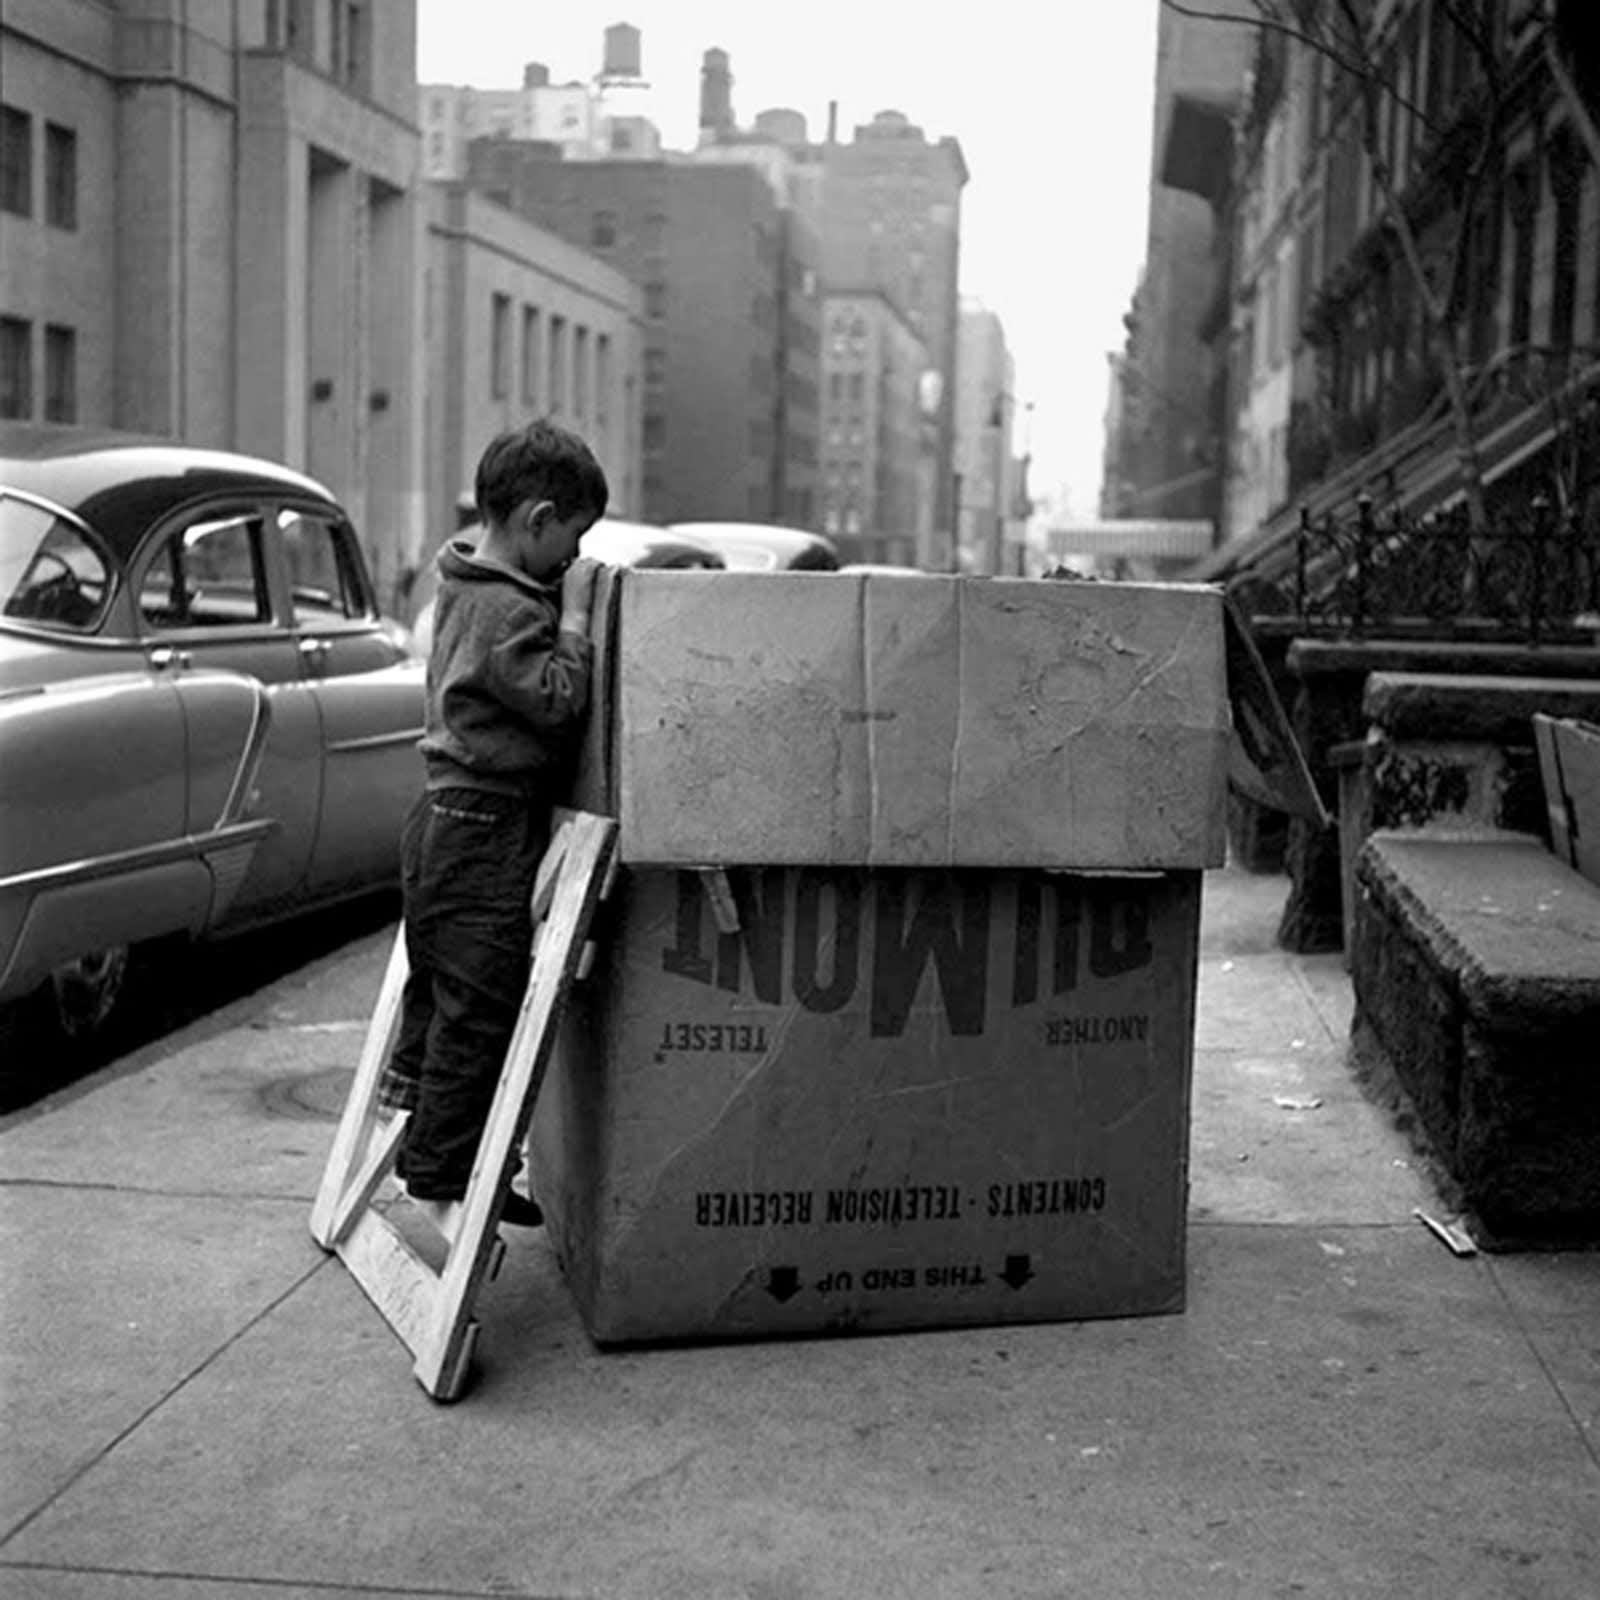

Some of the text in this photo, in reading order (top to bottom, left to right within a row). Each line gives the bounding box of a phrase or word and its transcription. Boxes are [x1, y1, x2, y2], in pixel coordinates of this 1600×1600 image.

[1045, 1016, 1149, 1045] ANOTHER
[696, 1178, 1105, 1226] CONTENTS TELEVISION RECEIVER
[816, 1266, 985, 1293] THIS END UP
